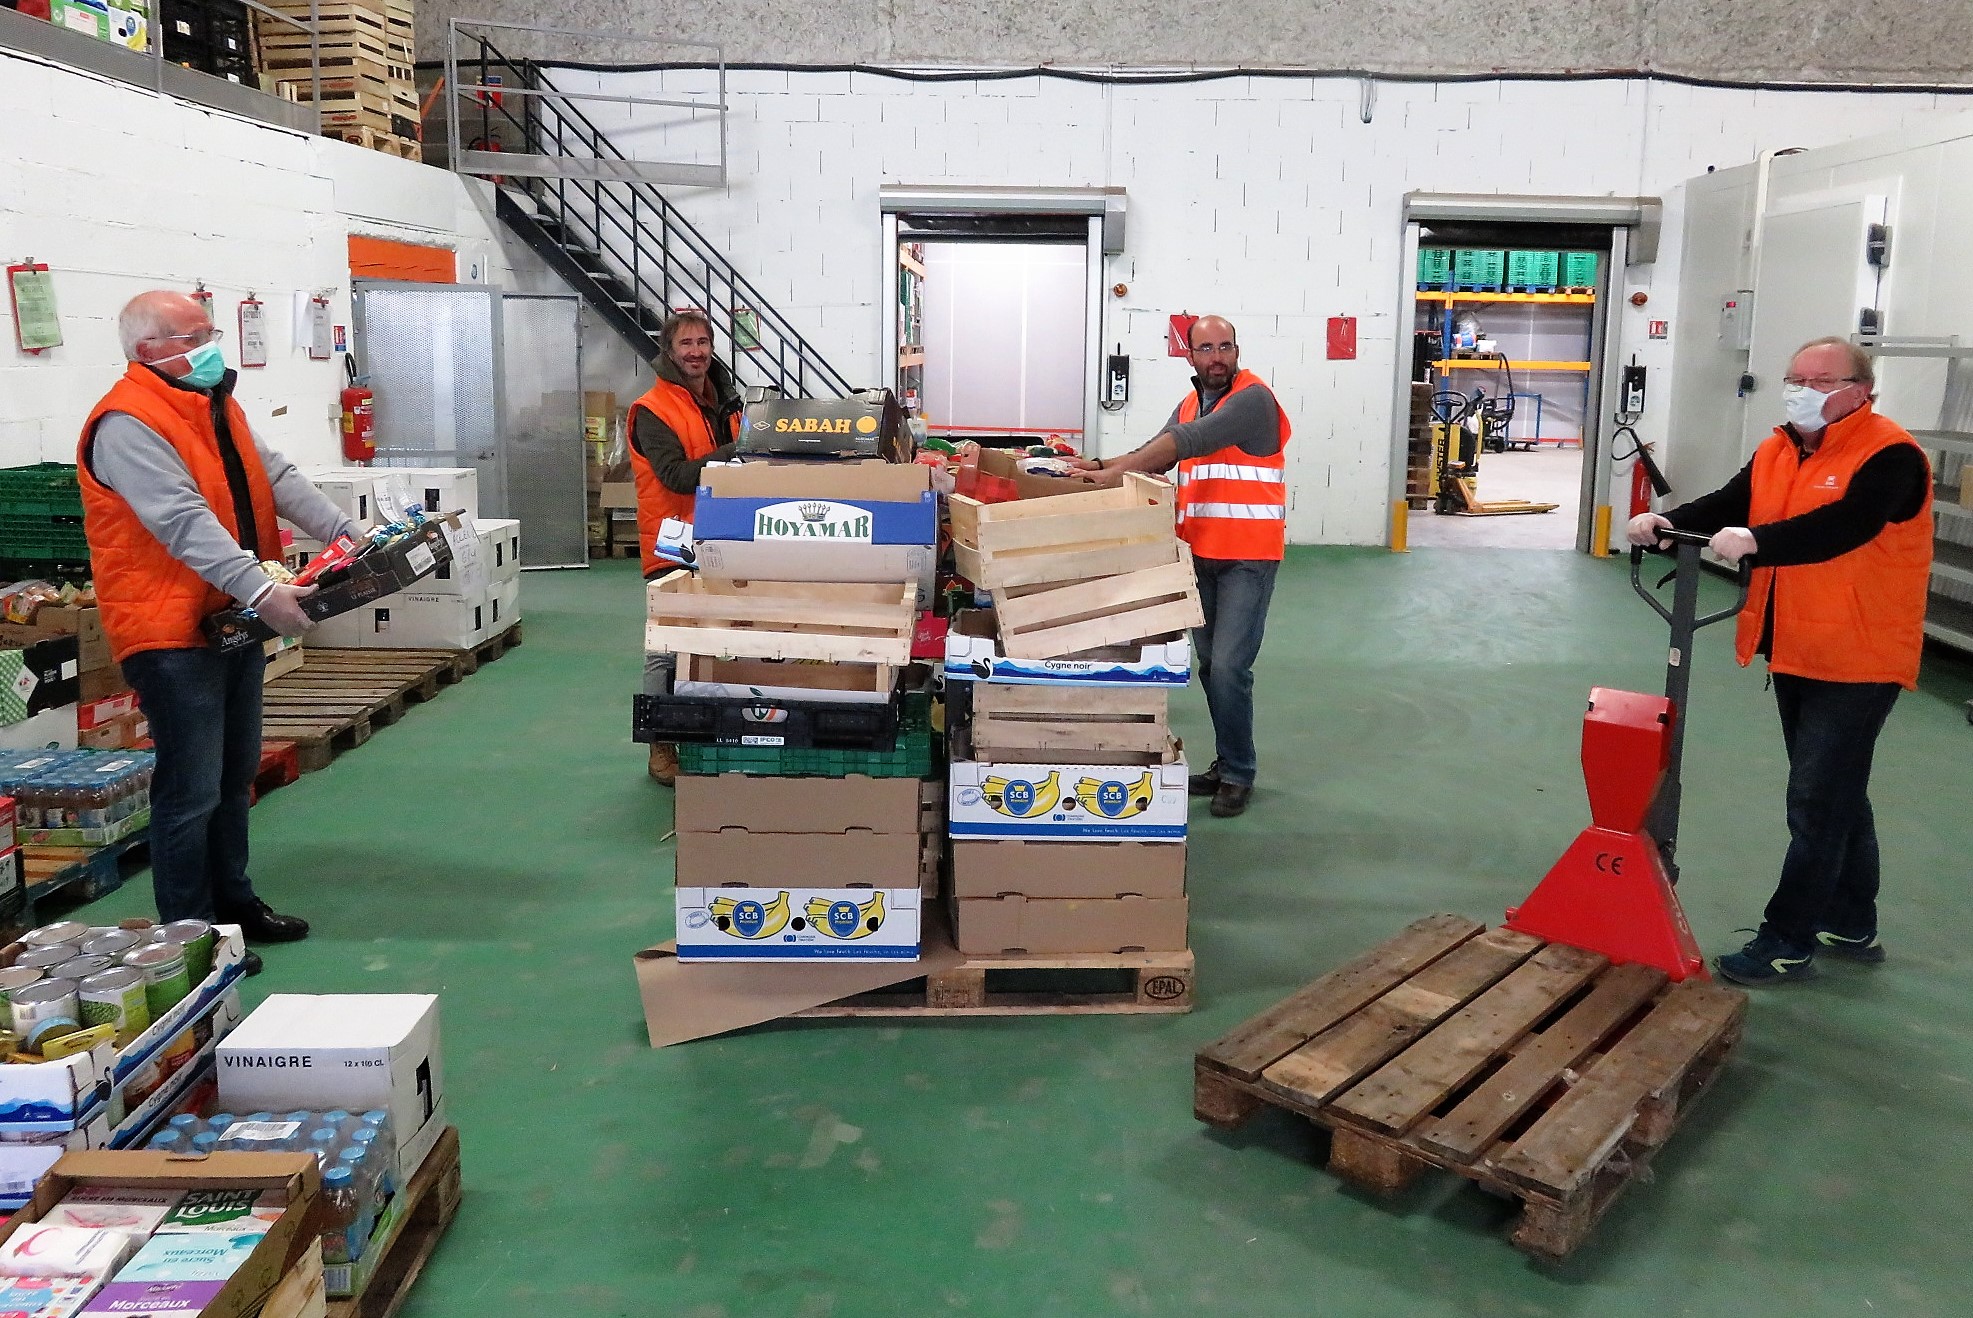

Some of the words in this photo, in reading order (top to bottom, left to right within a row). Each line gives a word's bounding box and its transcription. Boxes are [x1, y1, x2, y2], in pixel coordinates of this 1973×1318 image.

[775, 418, 851, 434] SABAH
[757, 513, 869, 538] HOYAMAR
[1044, 660, 1072, 670] Cygne
[1074, 661, 1091, 670] noir
[1010, 791, 1029, 799] SCB
[1103, 792, 1122, 800] SCB
[1596, 853, 1624, 875] CE
[738, 911, 759, 920] SCB
[834, 912, 854, 920] SCB
[1152, 980, 1180, 995] EPAL
[224, 1055, 312, 1068] VINAIGRE
[181, 1189, 256, 1206] SAINT
[175, 1201, 248, 1218] LOUIS
[163, 1248, 229, 1256] Morceaux
[183, 1256, 216, 1264] Sucre
[108, 1299, 191, 1310] Morceaux
